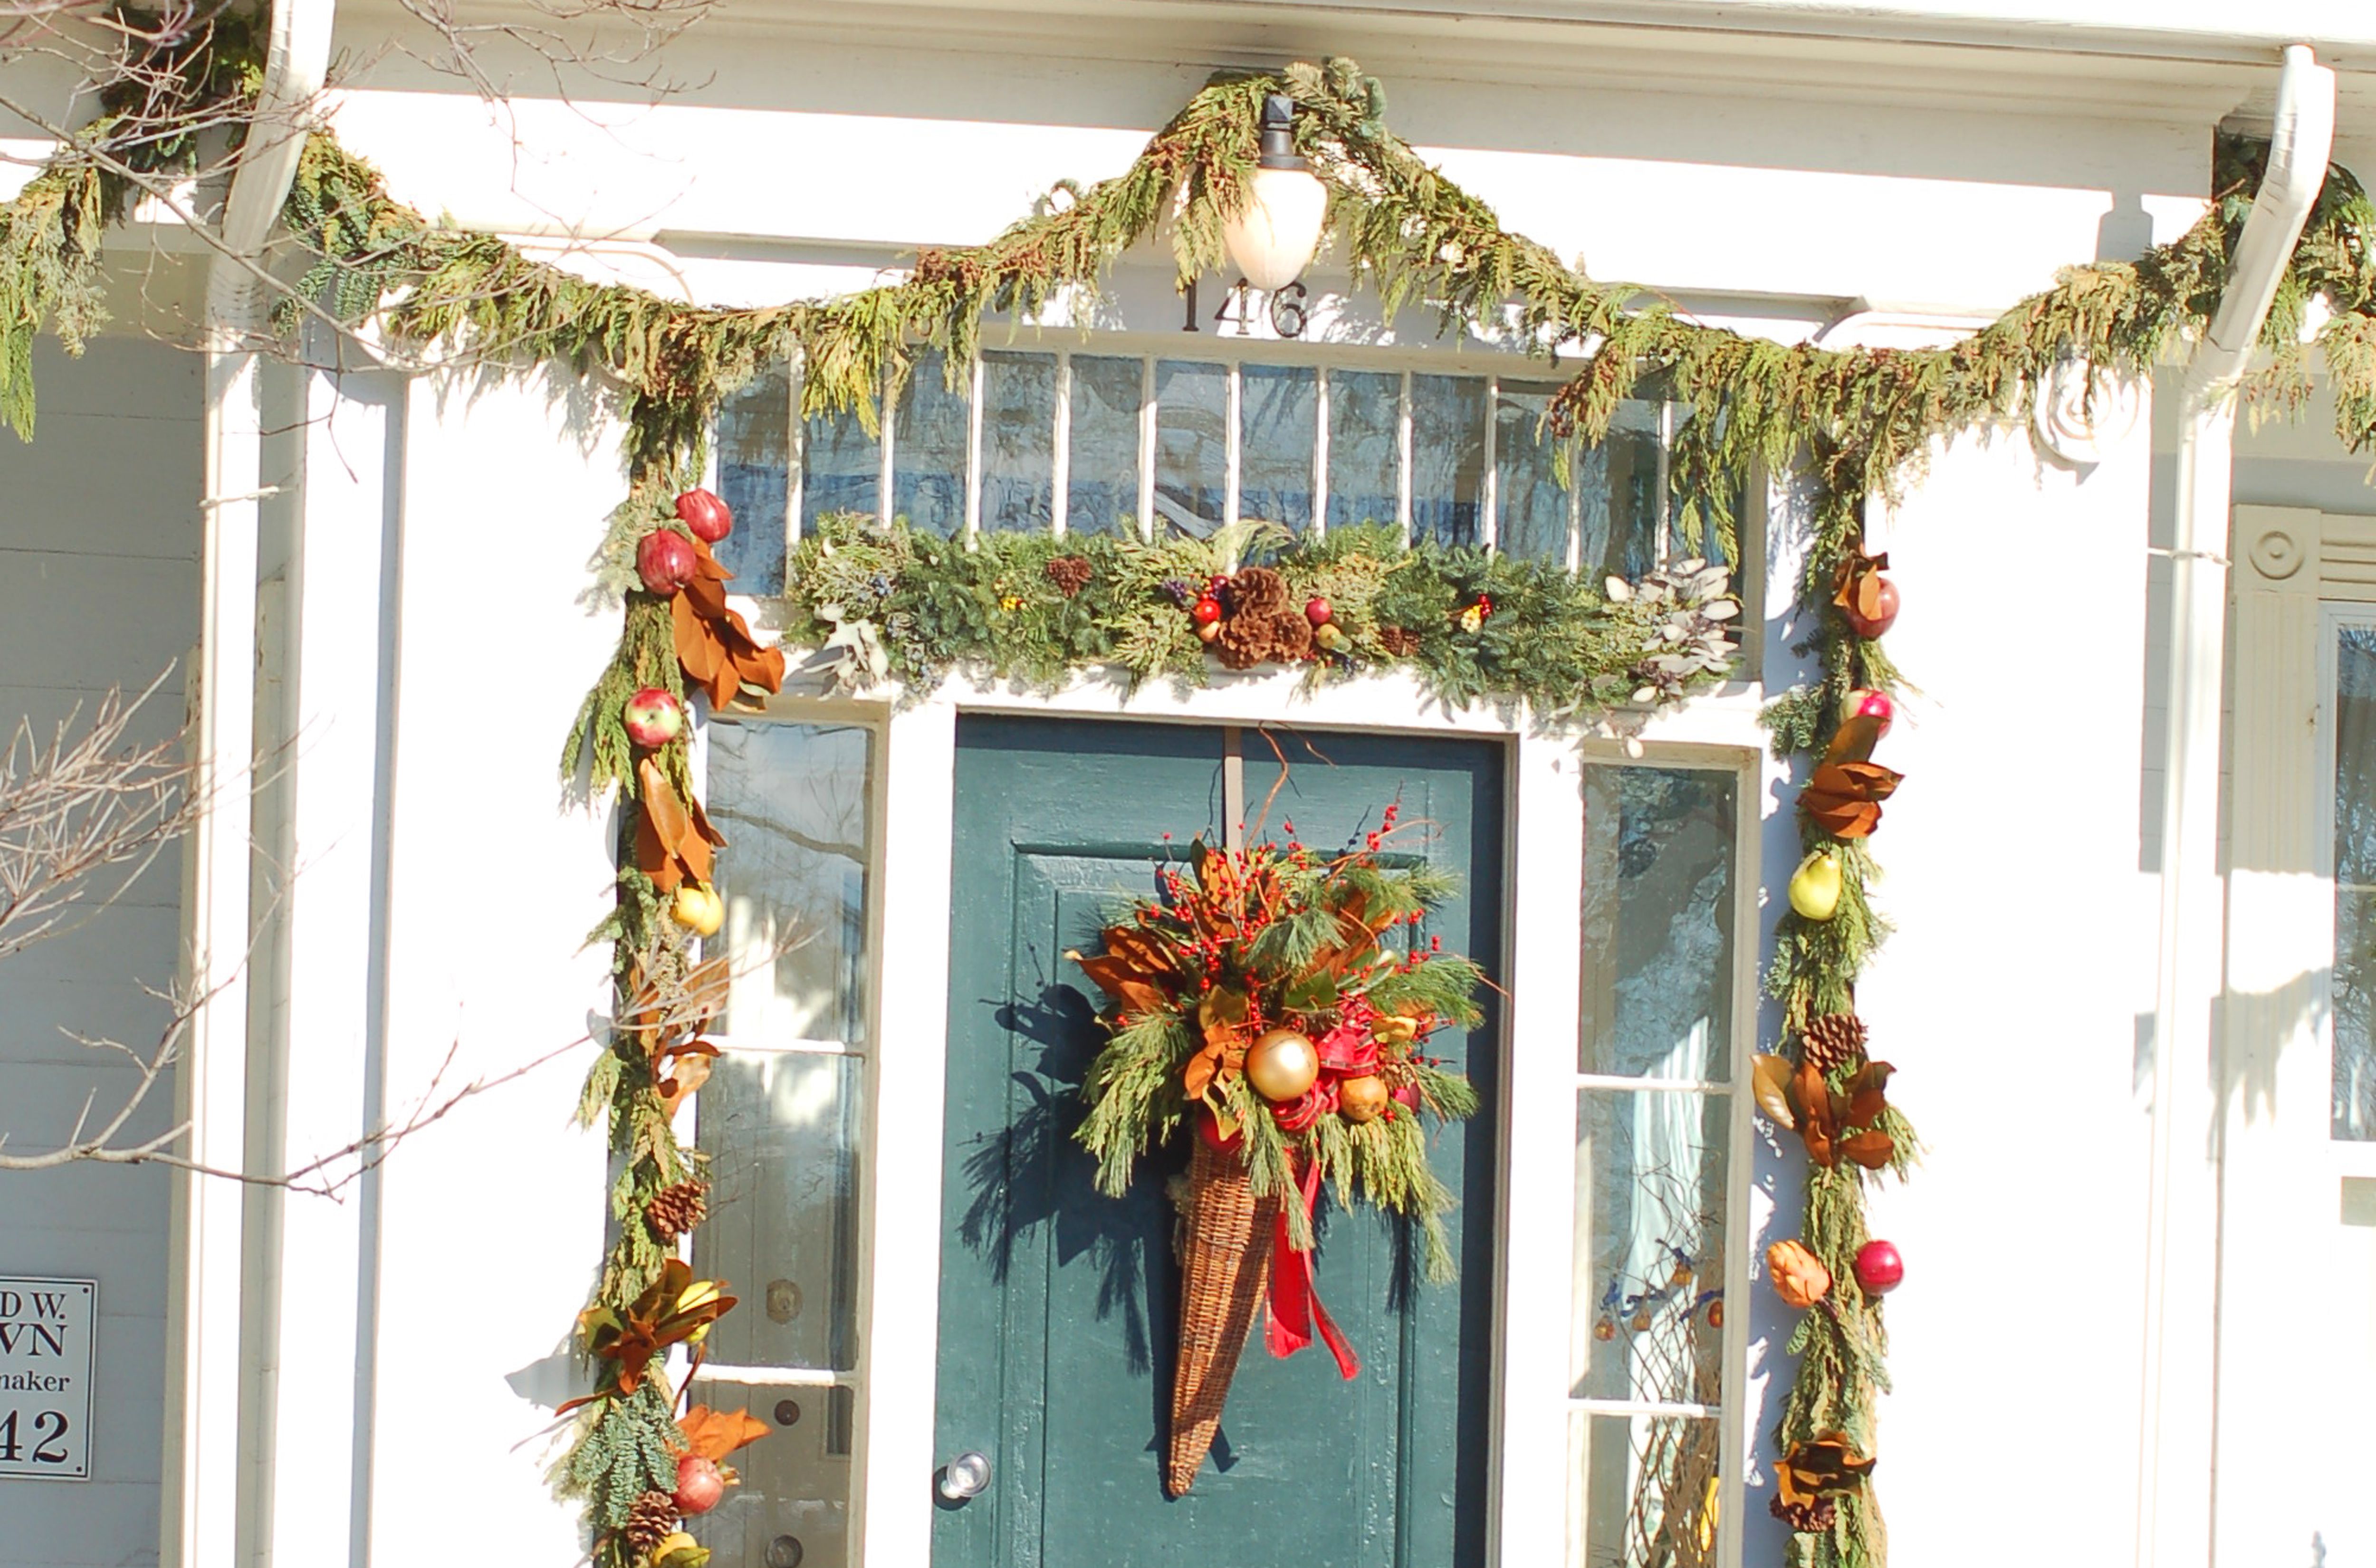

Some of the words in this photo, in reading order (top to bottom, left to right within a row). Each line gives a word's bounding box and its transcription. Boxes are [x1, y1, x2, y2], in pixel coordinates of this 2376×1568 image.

[1182, 277, 1307, 338] 146
[30, 1292, 66, 1319] W.
[0, 1410, 68, 1463] 42
